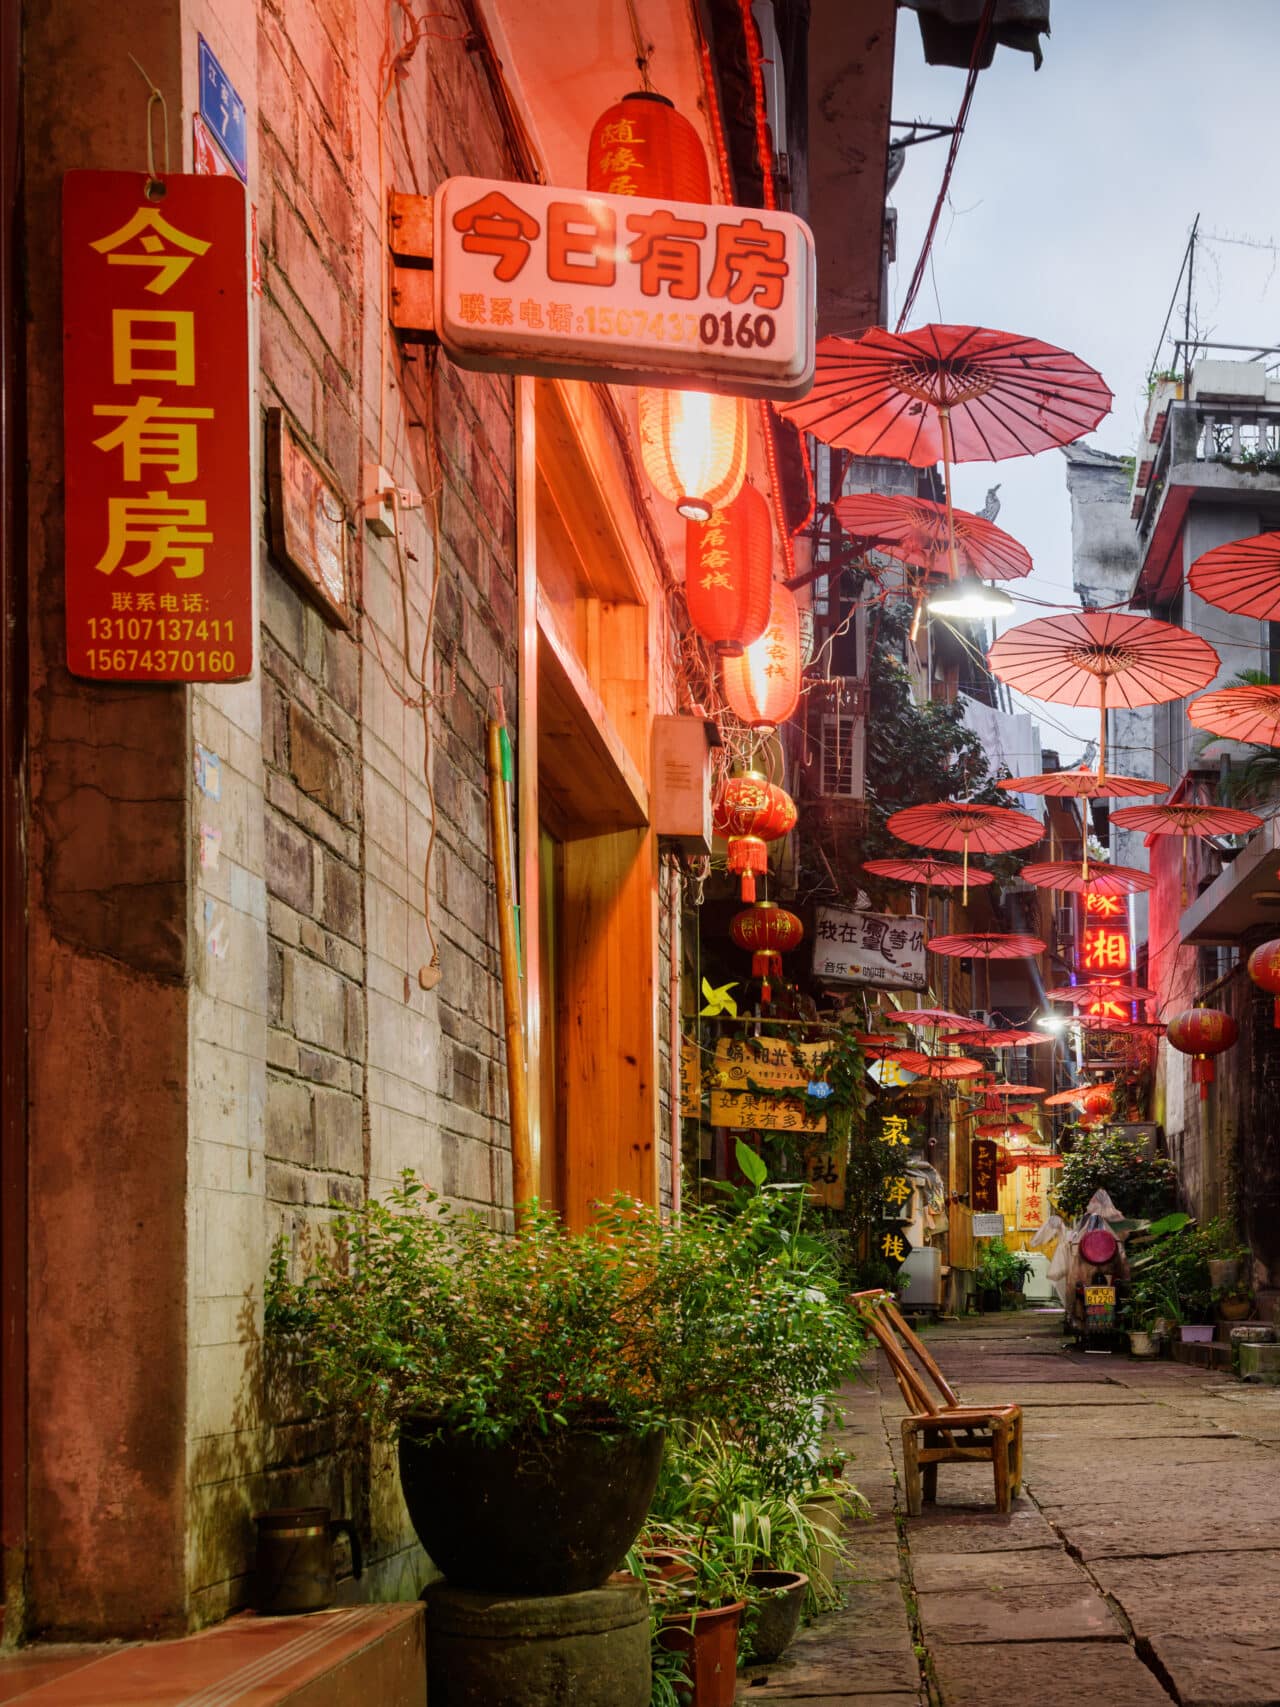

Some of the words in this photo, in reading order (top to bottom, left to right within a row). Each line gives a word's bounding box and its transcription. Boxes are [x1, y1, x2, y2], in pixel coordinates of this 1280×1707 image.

[453, 190, 789, 310] 今日有房
[89, 207, 214, 578] 今日有房
[111, 592, 210, 613] 联系电话:
[87, 618, 234, 642] 13107137411
[86, 649, 235, 673] 15674370160
